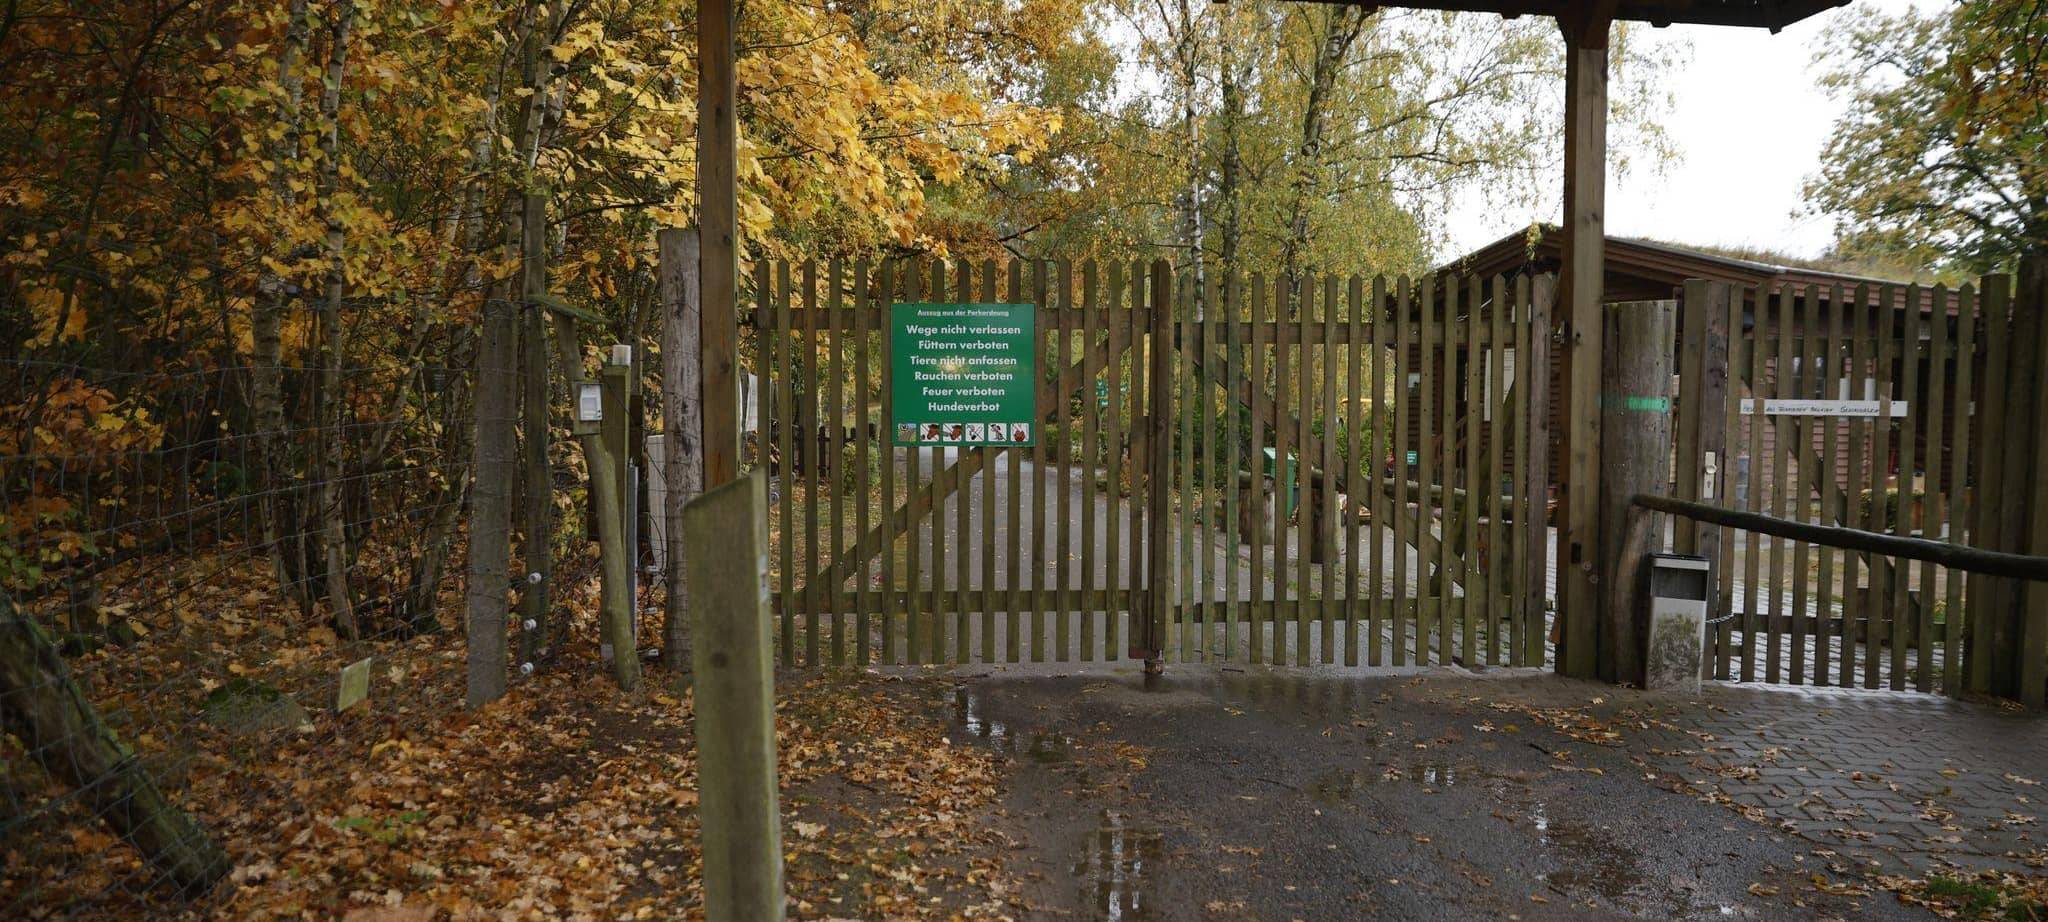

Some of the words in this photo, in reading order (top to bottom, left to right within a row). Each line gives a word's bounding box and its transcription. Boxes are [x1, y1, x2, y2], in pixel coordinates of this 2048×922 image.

[906, 325, 937, 335] Wege
[941, 324, 967, 334] nicht
[969, 325, 1021, 334] verlassen
[919, 340, 957, 349] Füttern
[960, 340, 1009, 349] verboten
[911, 356, 937, 365] Tiere
[940, 356, 965, 365] nicht
[968, 356, 1017, 365] anfassen
[915, 371, 960, 380] Rauchen
[964, 371, 1013, 380] verboten
[923, 387, 953, 395] Feuer
[956, 387, 1005, 396] verboten
[928, 402, 1000, 411] Hundeverbot
